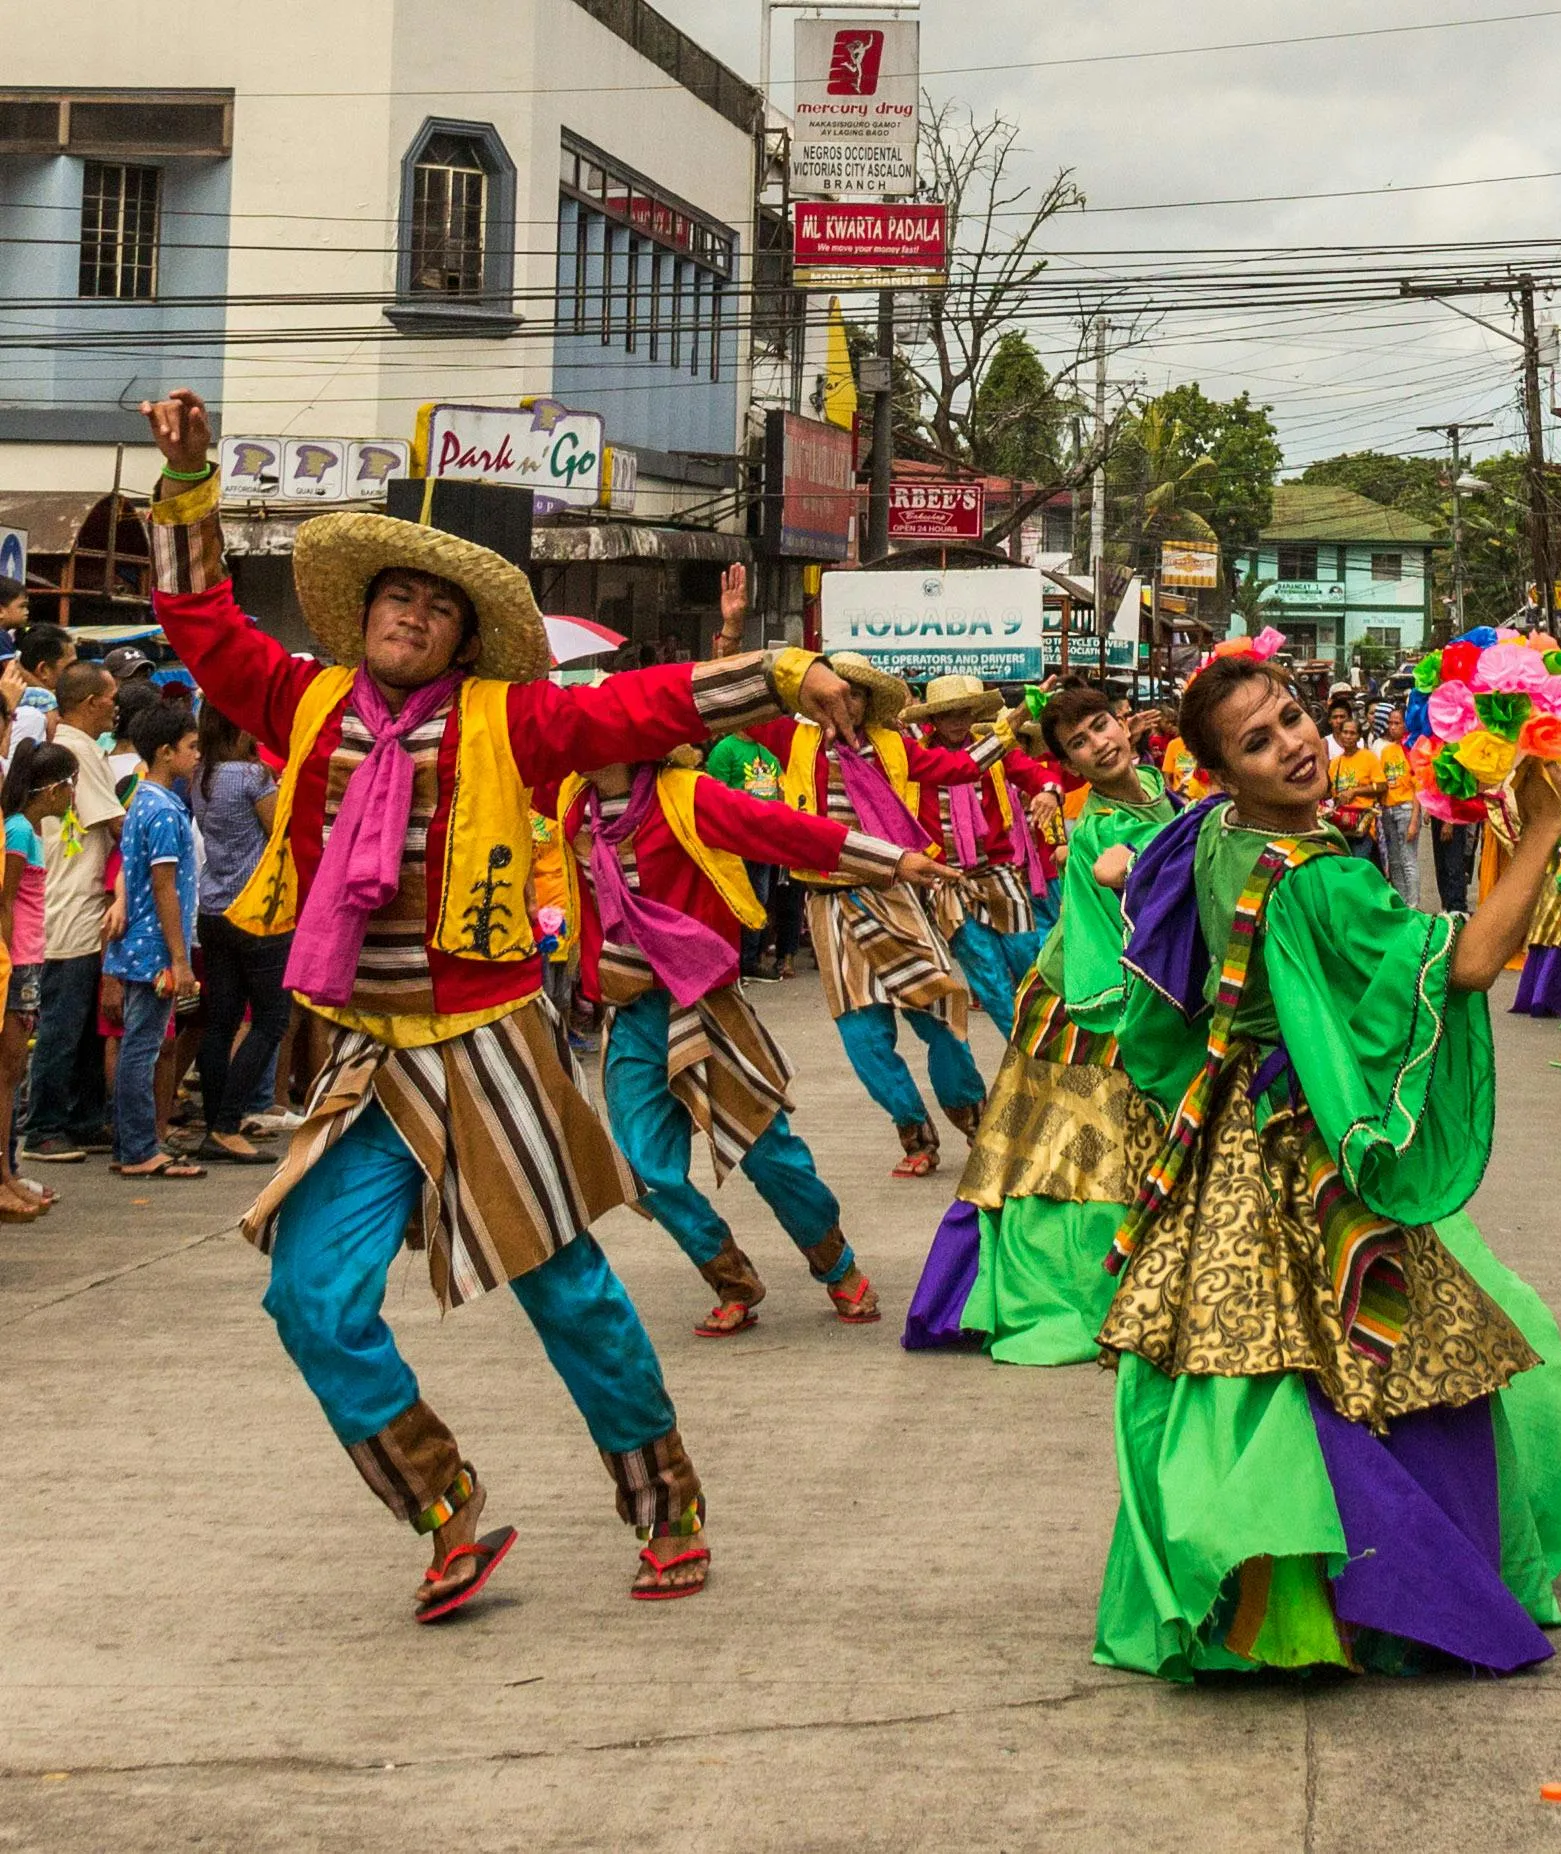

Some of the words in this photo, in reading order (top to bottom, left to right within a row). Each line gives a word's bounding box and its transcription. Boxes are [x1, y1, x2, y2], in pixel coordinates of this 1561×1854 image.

[797, 103, 868, 116] mercury
[876, 102, 913, 117] drug
[803, 146, 842, 160] NEGROS
[845, 147, 902, 161] OCCIDENTAL
[794, 162, 842, 176] VICTORIAS
[845, 163, 866, 177] CITY
[868, 164, 911, 178] ASCALON
[824, 179, 886, 190] BRANCH
[802, 215, 821, 238] ML
[826, 216, 882, 239] KWARTA
[888, 216, 940, 241] PADALA
[818, 243, 830, 251] We
[854, 246, 872, 254] your
[874, 246, 899, 254] money
[901, 245, 919, 255] fast!
[811, 272, 858, 284] MONEY
[439, 431, 516, 476] Park
[550, 432, 597, 487] Go
[887, 487, 977, 510] RBEE'S
[893, 525, 916, 533] OPEN
[917, 525, 927, 533] 24
[929, 525, 958, 533] HOURS
[843, 607, 993, 637] TODABA
[1000, 606, 1023, 636] 9
[892, 654, 953, 665] OPERATORS
[955, 654, 978, 665] AND
[980, 653, 1025, 665] DRIVERS
[928, 666, 943, 676] OF
